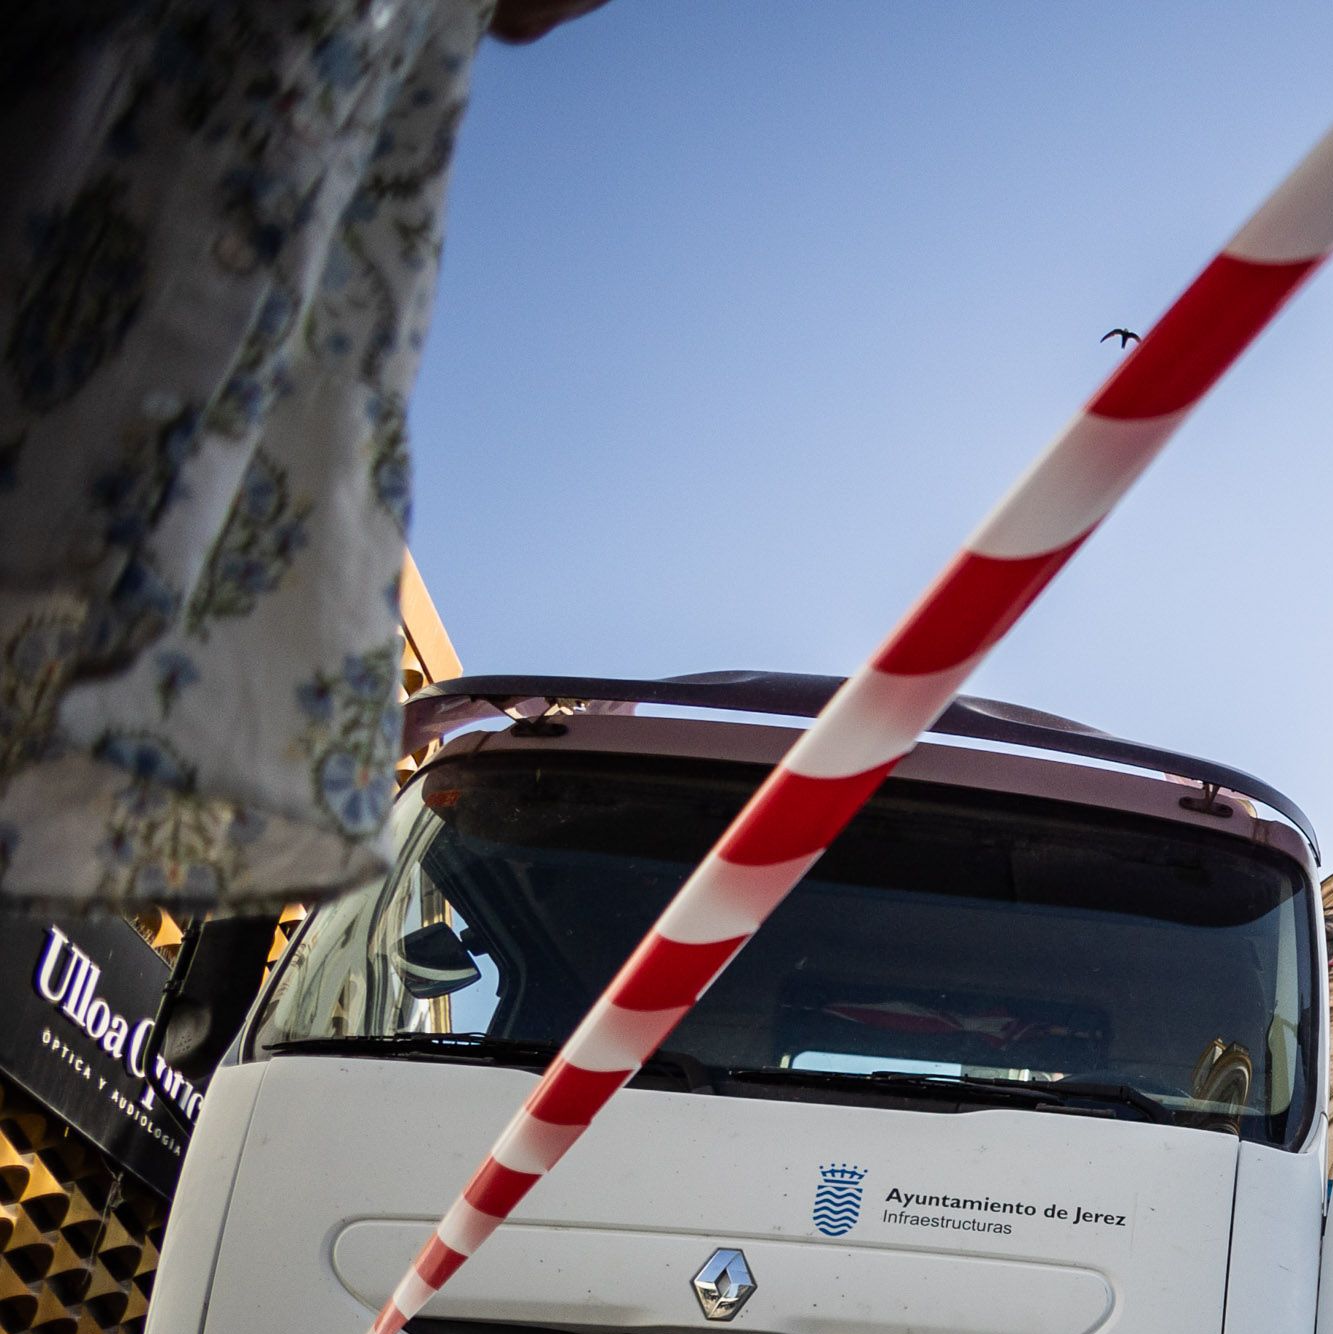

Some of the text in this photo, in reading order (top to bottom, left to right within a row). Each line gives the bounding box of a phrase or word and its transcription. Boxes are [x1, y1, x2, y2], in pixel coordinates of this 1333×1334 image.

[38, 924, 128, 1060] Ulloa
[99, 1077, 107, 1090] Y
[883, 1209, 1012, 1235] Infraestructuras
[885, 1187, 1127, 1227] Ayuntamiento de Jerez
